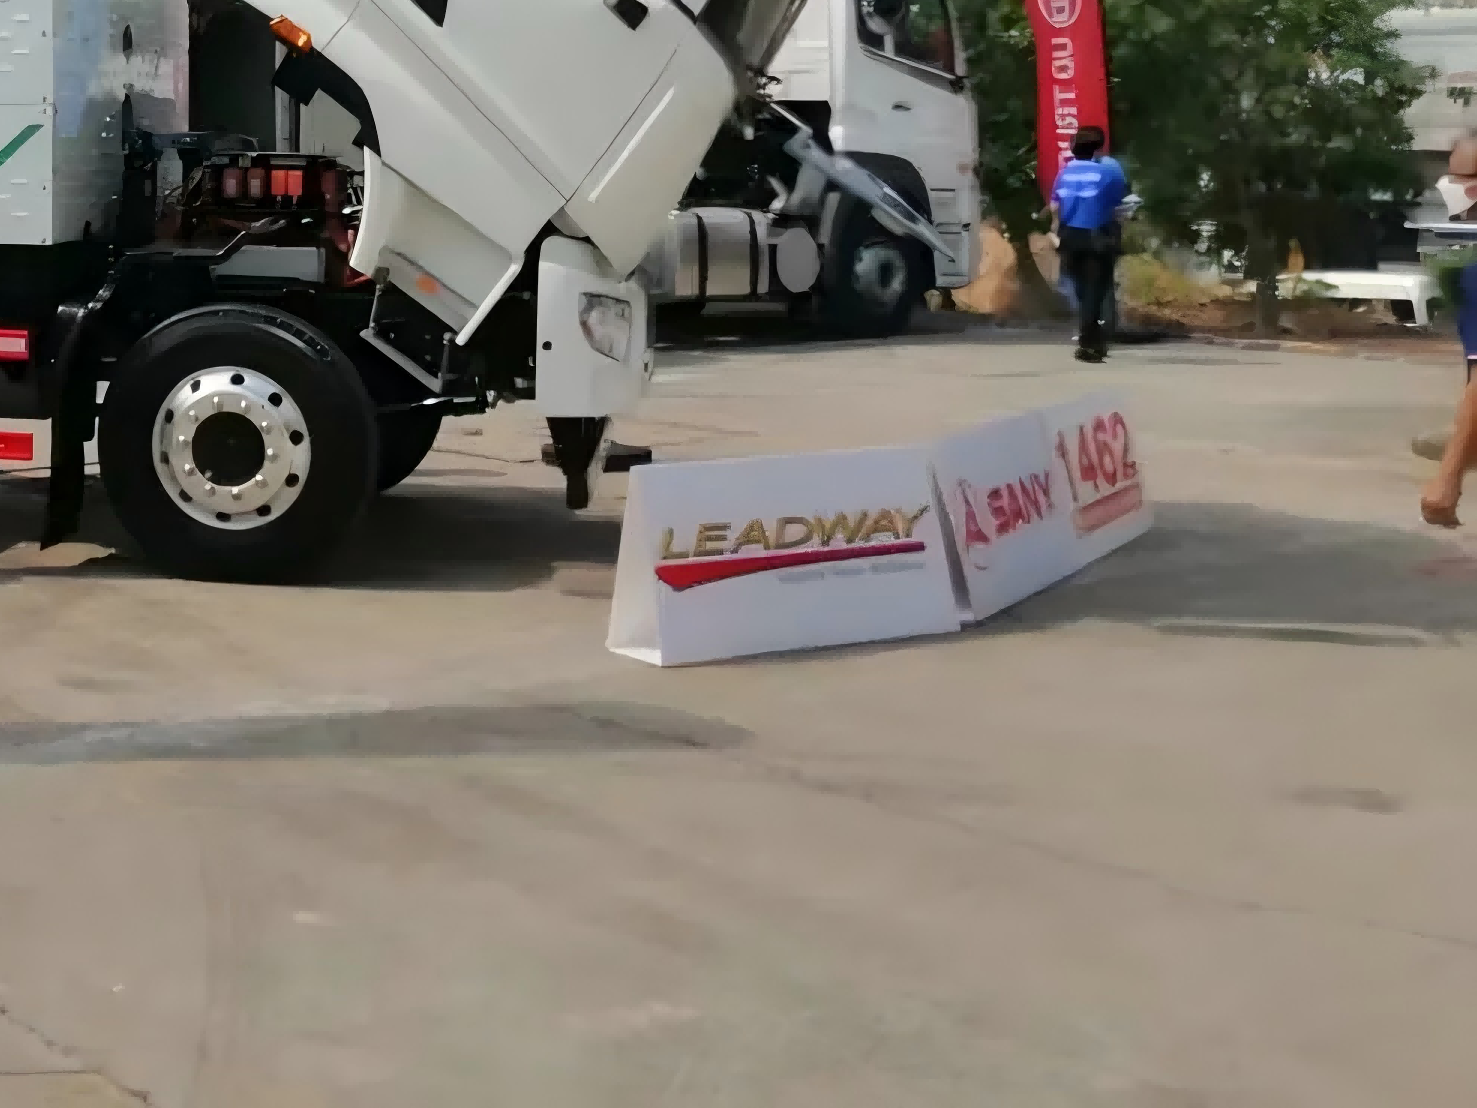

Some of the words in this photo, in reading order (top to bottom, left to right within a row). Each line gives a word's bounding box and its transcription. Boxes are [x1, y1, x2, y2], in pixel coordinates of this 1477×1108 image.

[1055, 411, 1139, 502] 1462
[661, 502, 931, 560] LEADWAY
[986, 469, 1055, 540] SANY
